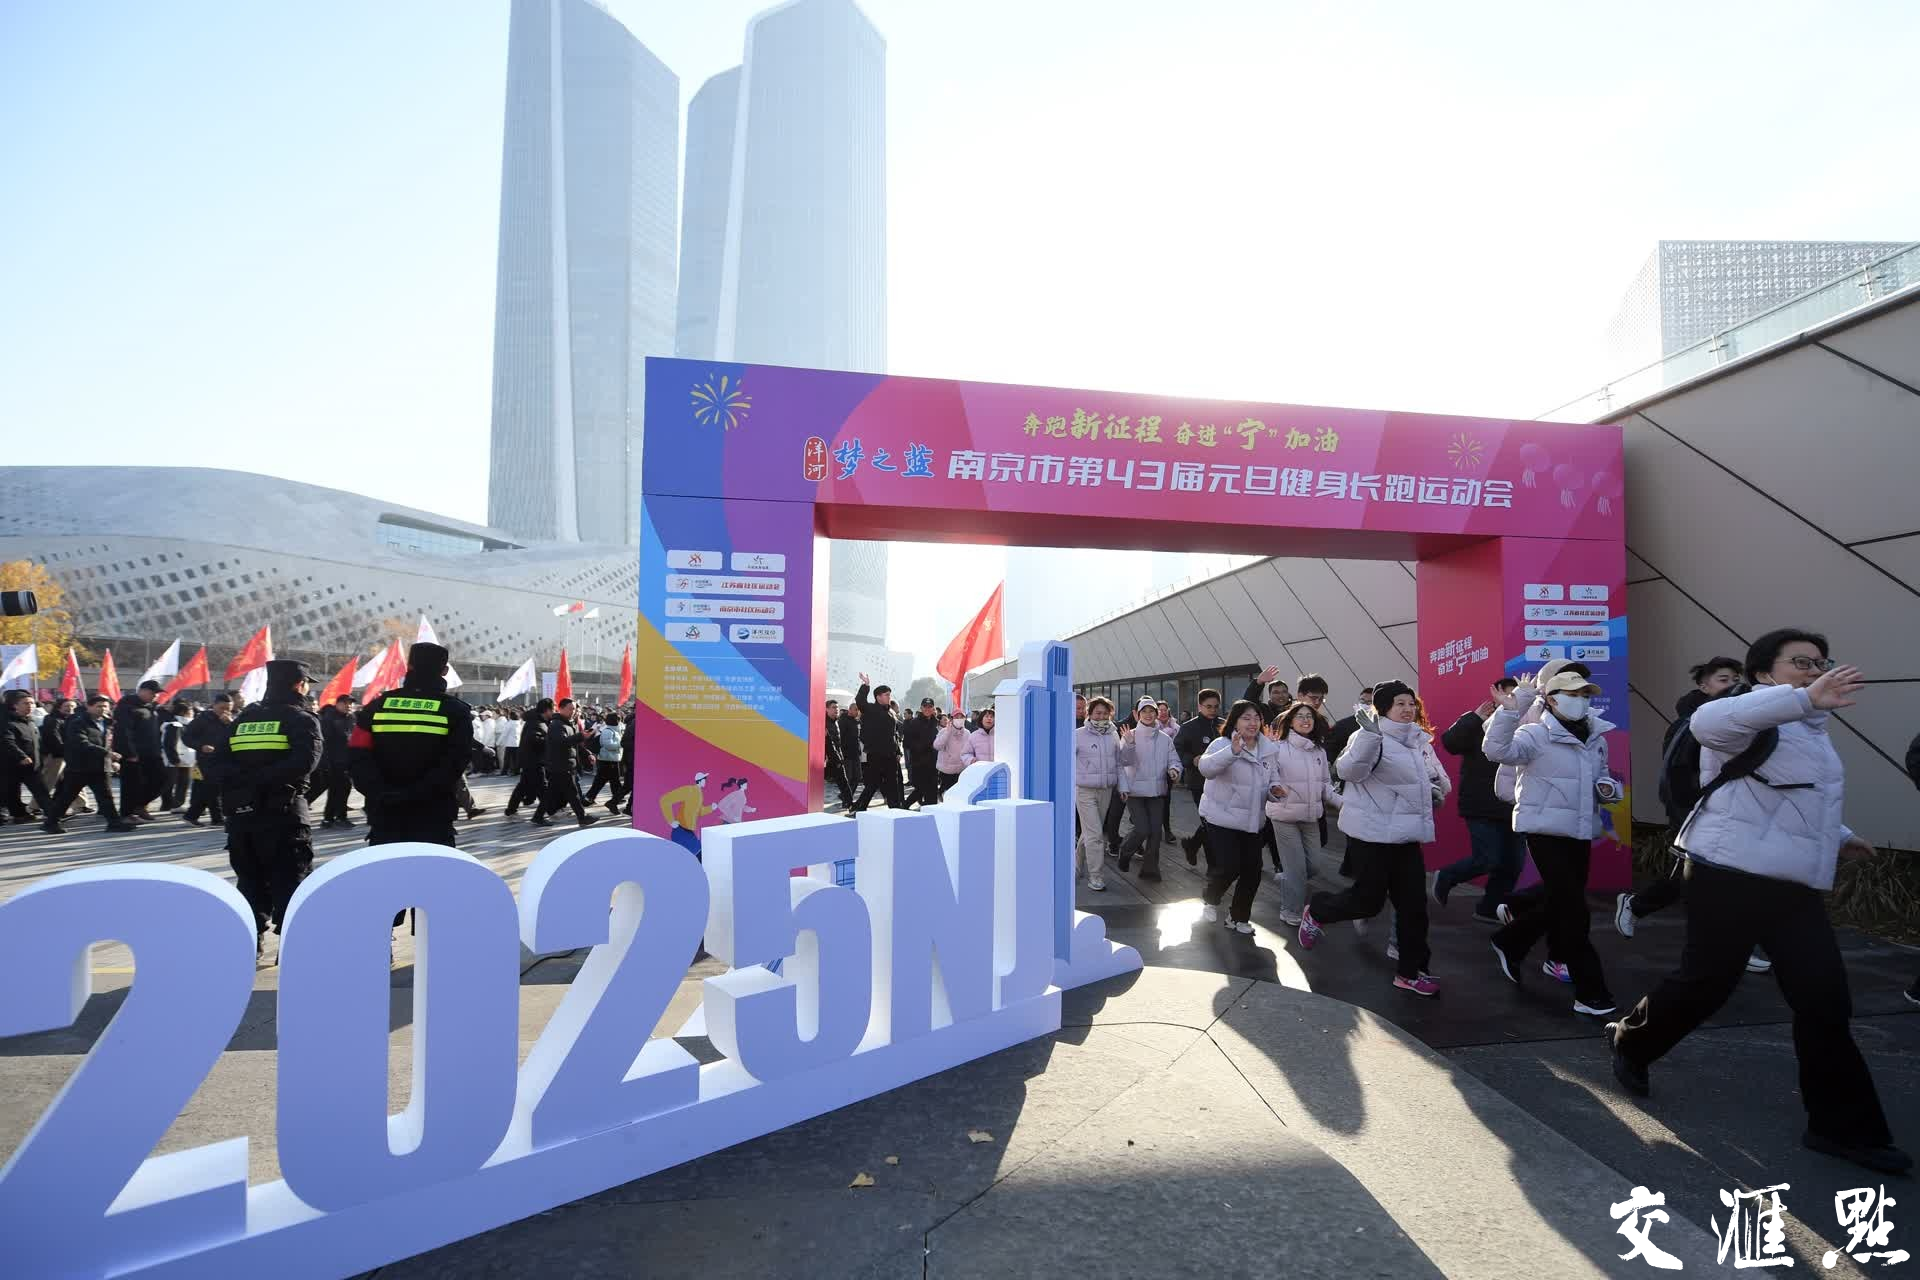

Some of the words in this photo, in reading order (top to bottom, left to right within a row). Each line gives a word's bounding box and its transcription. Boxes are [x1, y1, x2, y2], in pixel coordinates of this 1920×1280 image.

[1023, 407, 1163, 443] 奔跑新征程
[806, 440, 826, 478] 洋河
[833, 438, 936, 480] 梦之蓝
[947, 449, 1514, 509] 南京市第43届元旦健身长跑运动会
[1429, 635, 1473, 664] 奔跑新征程
[0, 799, 1053, 1278] 2025NJ
